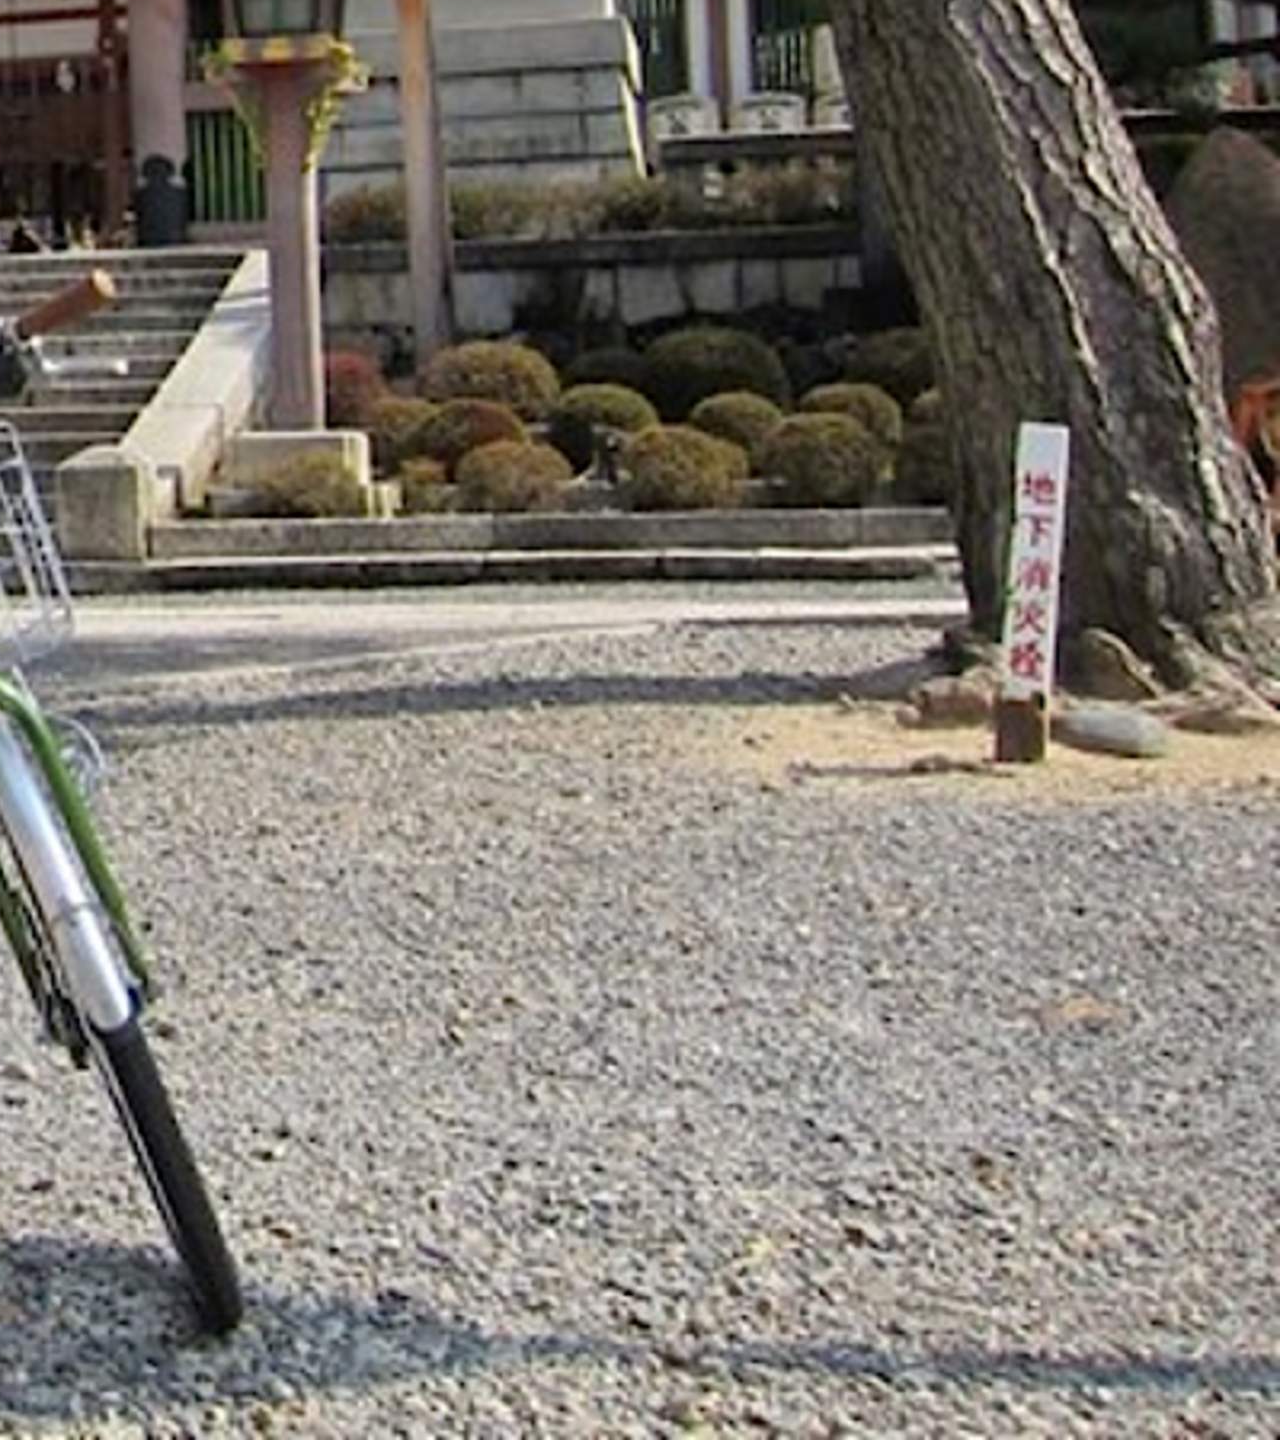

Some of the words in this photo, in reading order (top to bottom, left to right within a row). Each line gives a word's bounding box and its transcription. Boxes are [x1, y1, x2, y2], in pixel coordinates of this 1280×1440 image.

[1010, 470, 1057, 677] 地下消火栓
